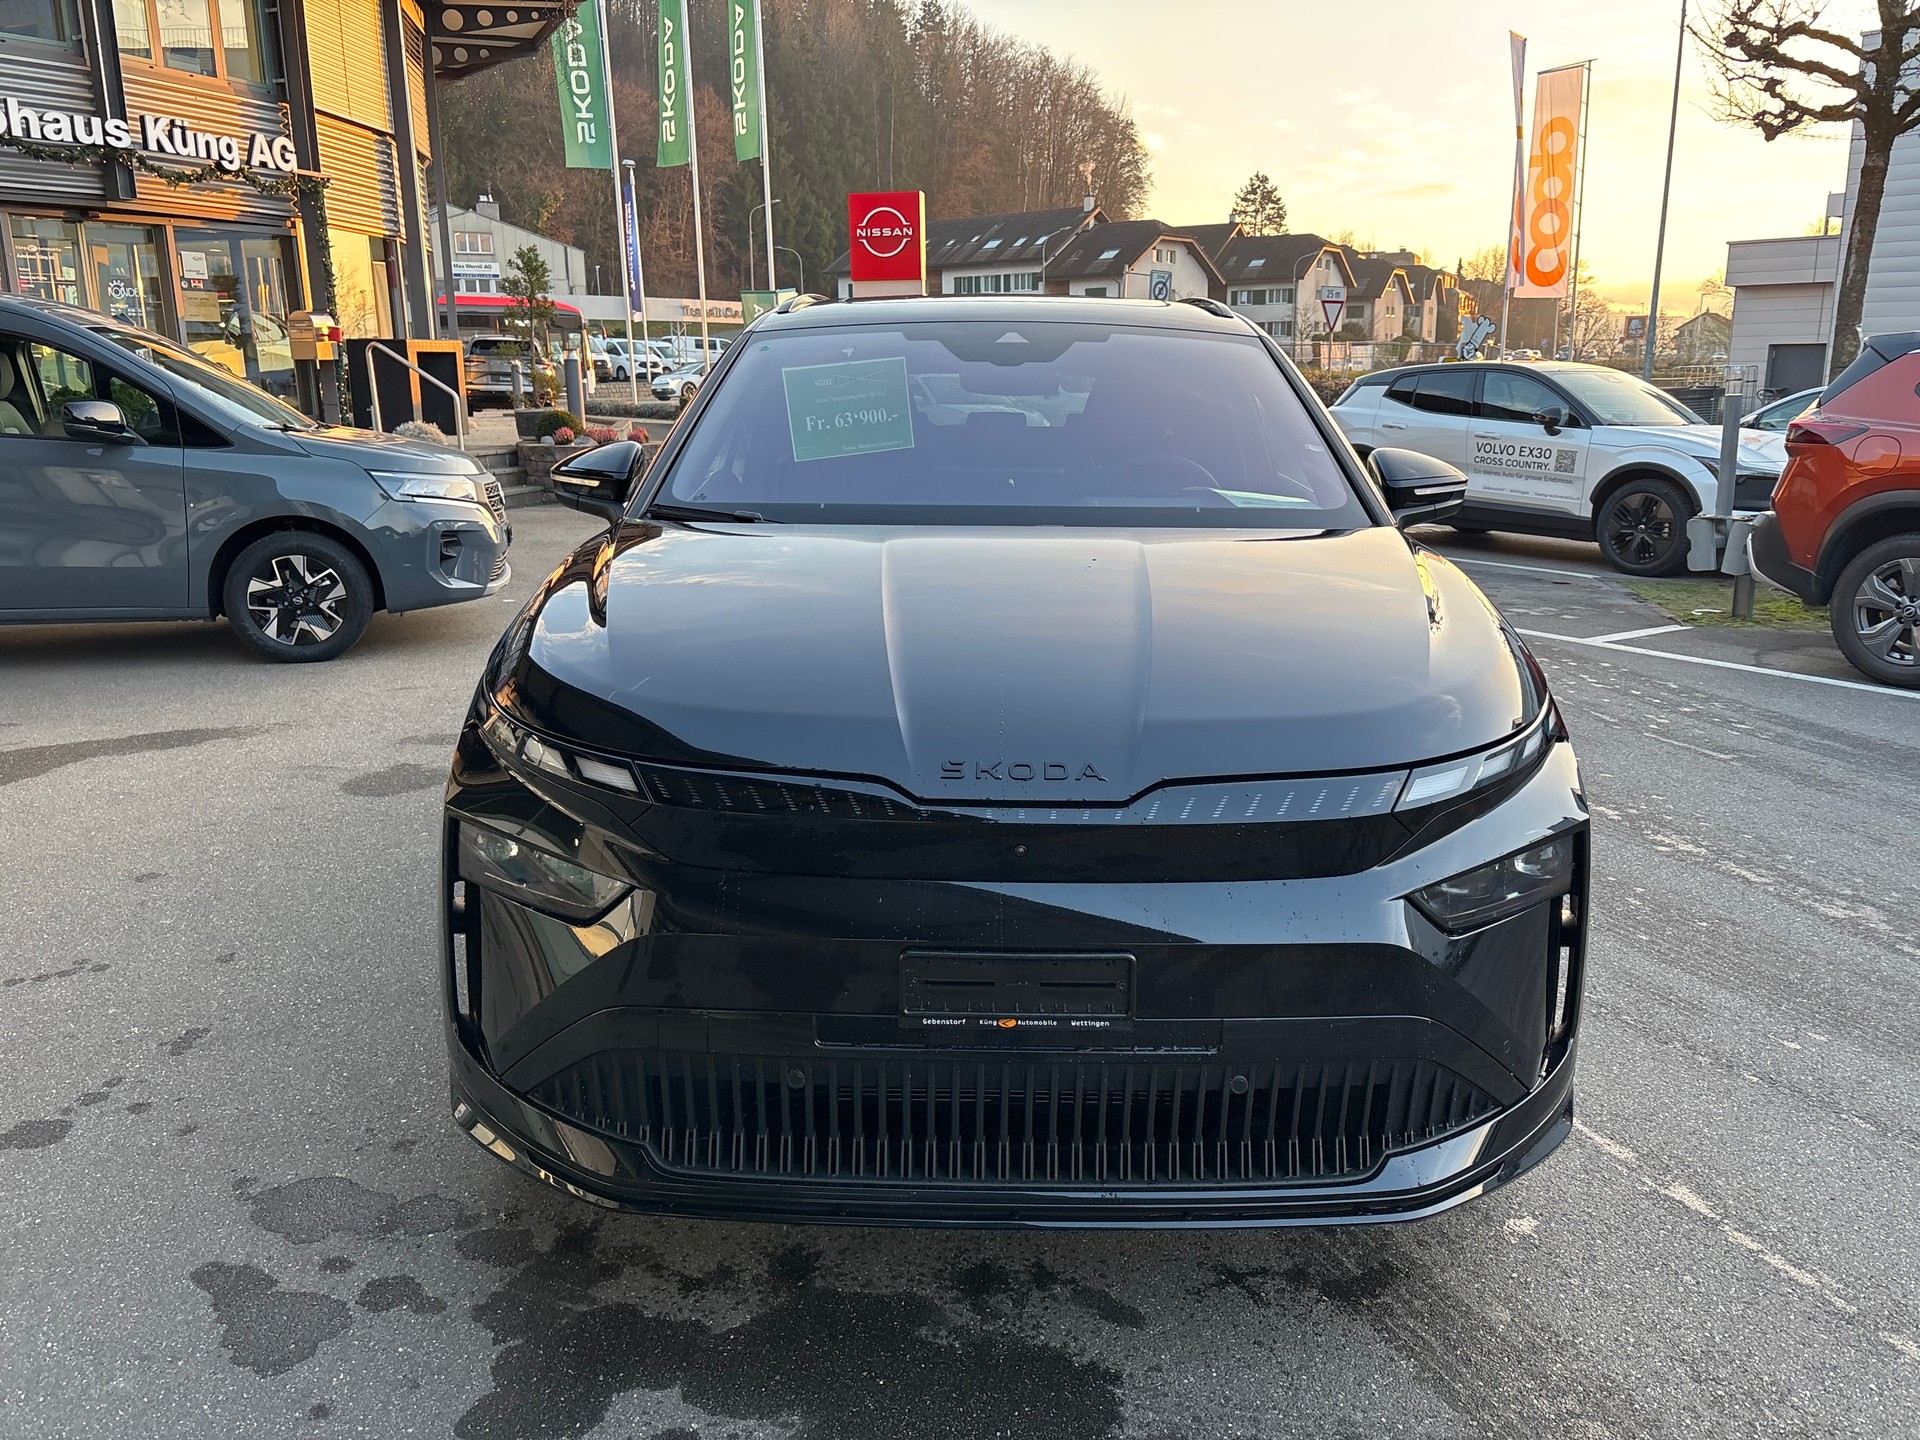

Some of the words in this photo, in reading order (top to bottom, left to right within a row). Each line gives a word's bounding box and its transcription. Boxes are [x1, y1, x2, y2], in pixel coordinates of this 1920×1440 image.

[0, 97, 132, 148] haus
[142, 115, 241, 172] Küng
[251, 134, 298, 172] AG
[856, 227, 913, 237] NISSAN
[1326, 289, 1334, 298] 25
[814, 378, 833, 388] statt
[805, 415, 831, 432] Fr.
[1476, 441, 1516, 456] VOLVO
[1518, 446, 1552, 460] EX30
[1473, 456, 1503, 467] CROSS
[1505, 459, 1551, 471] COUNTRY.
[1483, 468, 1501, 477] kleines
[1502, 471, 1515, 479] Auto
[1515, 472, 1524, 480] für
[1524, 474, 1543, 482] grosse
[1543, 475, 1574, 485] Erlebnisse.
[922, 1018, 967, 1026] Gebenstorf
[979, 1018, 997, 1027] Küng
[1017, 1019, 1058, 1027] Automobile
[1071, 1019, 1110, 1028] Wettingen
